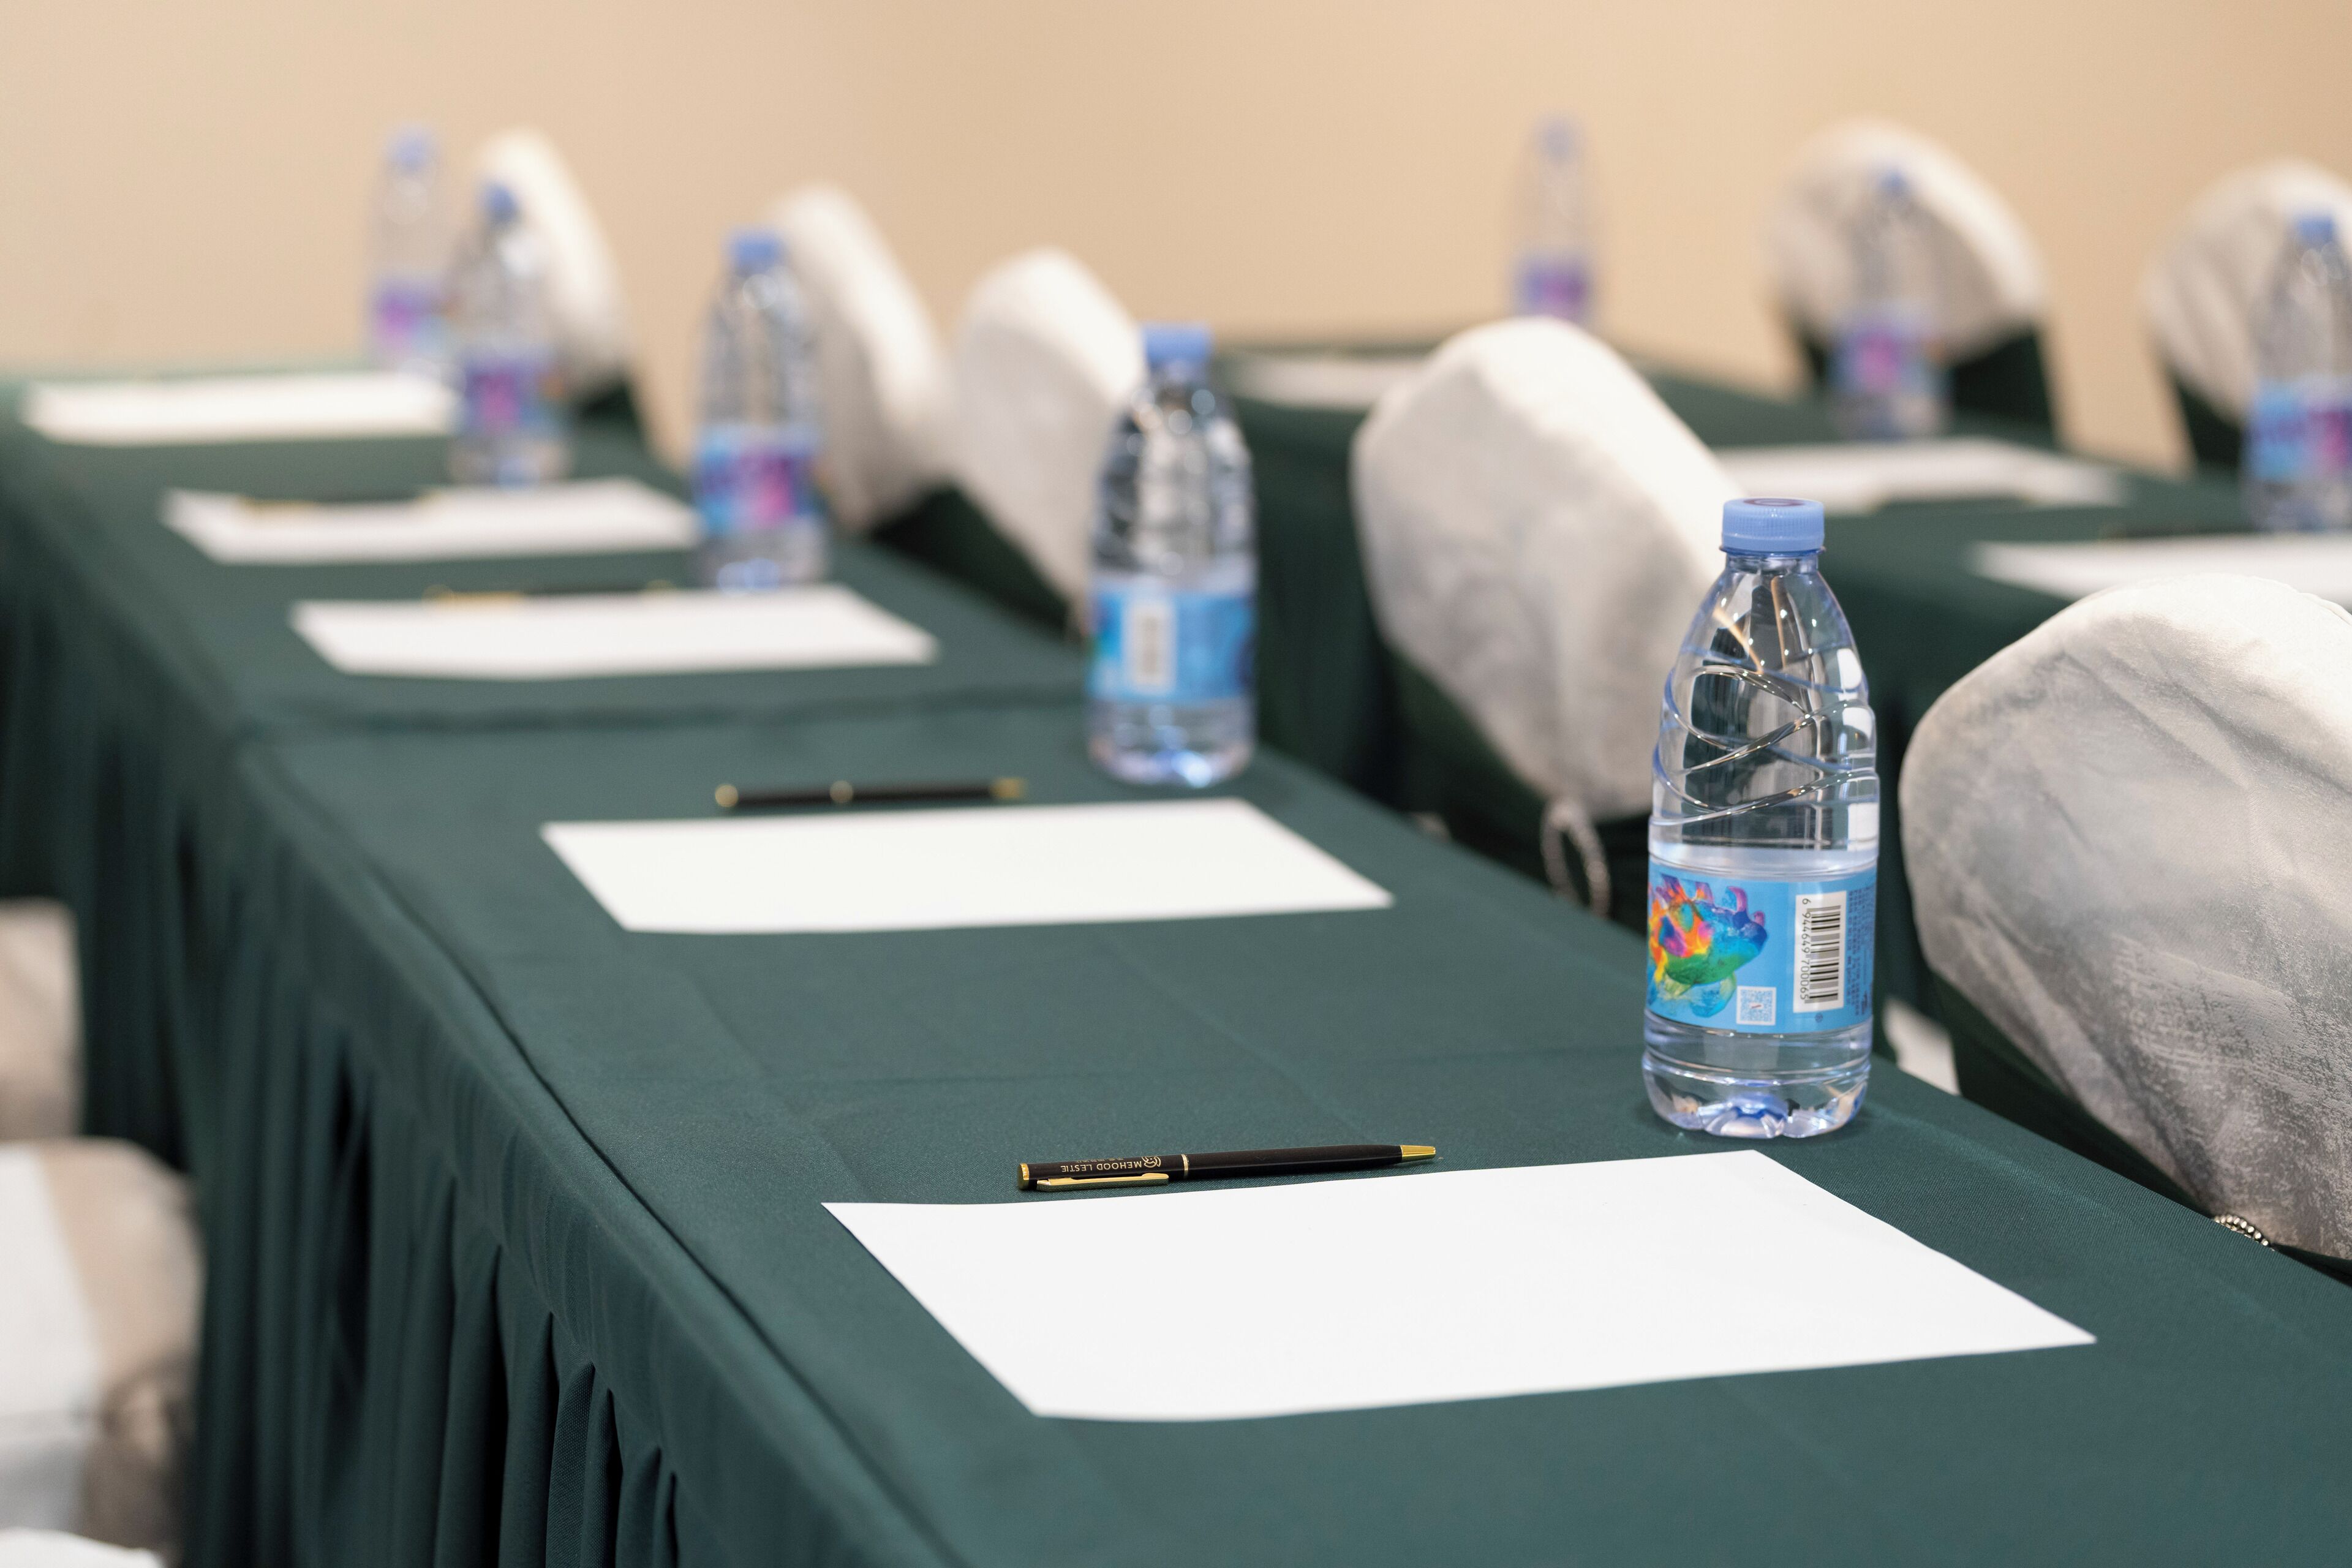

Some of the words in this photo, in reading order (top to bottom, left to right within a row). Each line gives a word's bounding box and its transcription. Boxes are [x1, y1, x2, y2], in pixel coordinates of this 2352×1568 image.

[1801, 912, 1811, 953] 944649
[1800, 959, 1809, 1000] 700065
[1096, 1161, 1142, 1170] MEHOOD
